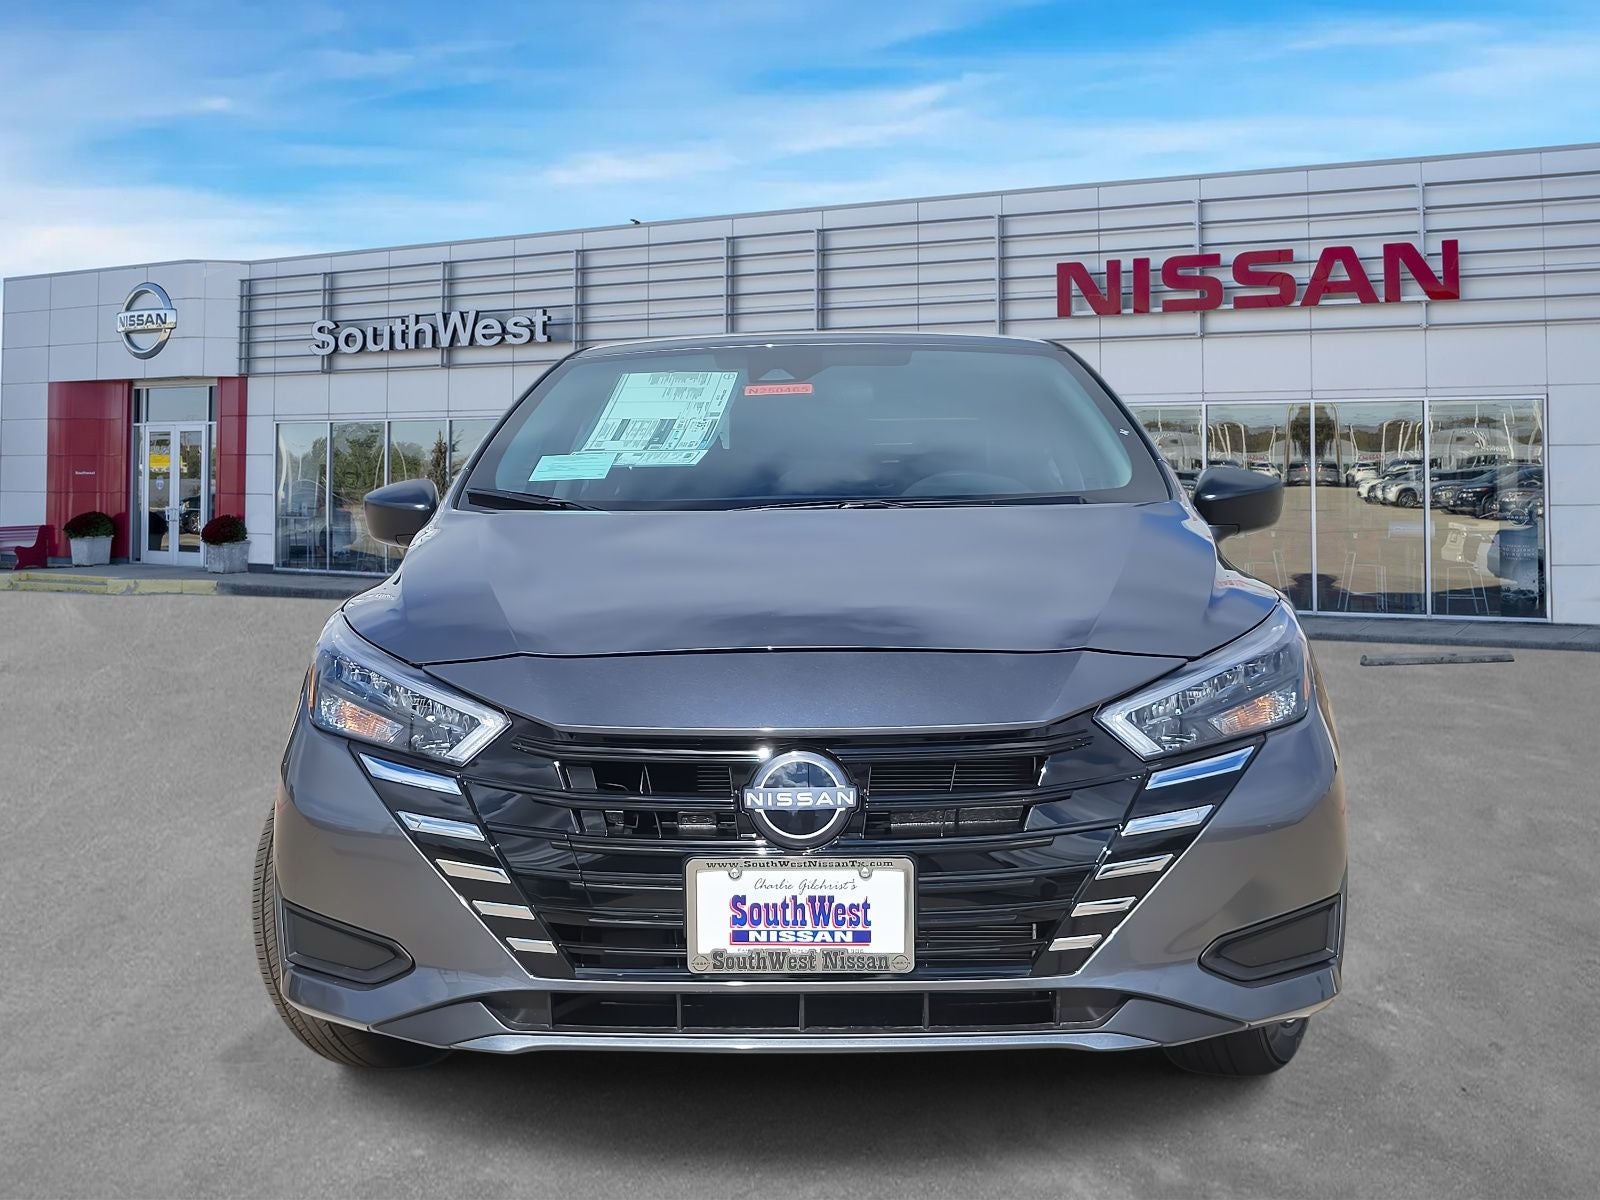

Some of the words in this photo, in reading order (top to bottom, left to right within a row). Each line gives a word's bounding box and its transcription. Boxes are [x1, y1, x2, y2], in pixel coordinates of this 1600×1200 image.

[1056, 239, 1460, 317] NISSAN
[119, 313, 167, 328] NISSAN
[310, 309, 551, 356] SouthWest
[746, 790, 855, 807] NISSAN
[754, 878, 793, 890] Charlie
[798, 878, 857, 895] Gilchrist's
[730, 894, 872, 928] SouthWest
[748, 930, 853, 942] NISSAN
[712, 951, 817, 971] SouthWest
[822, 951, 891, 971] Nissan
